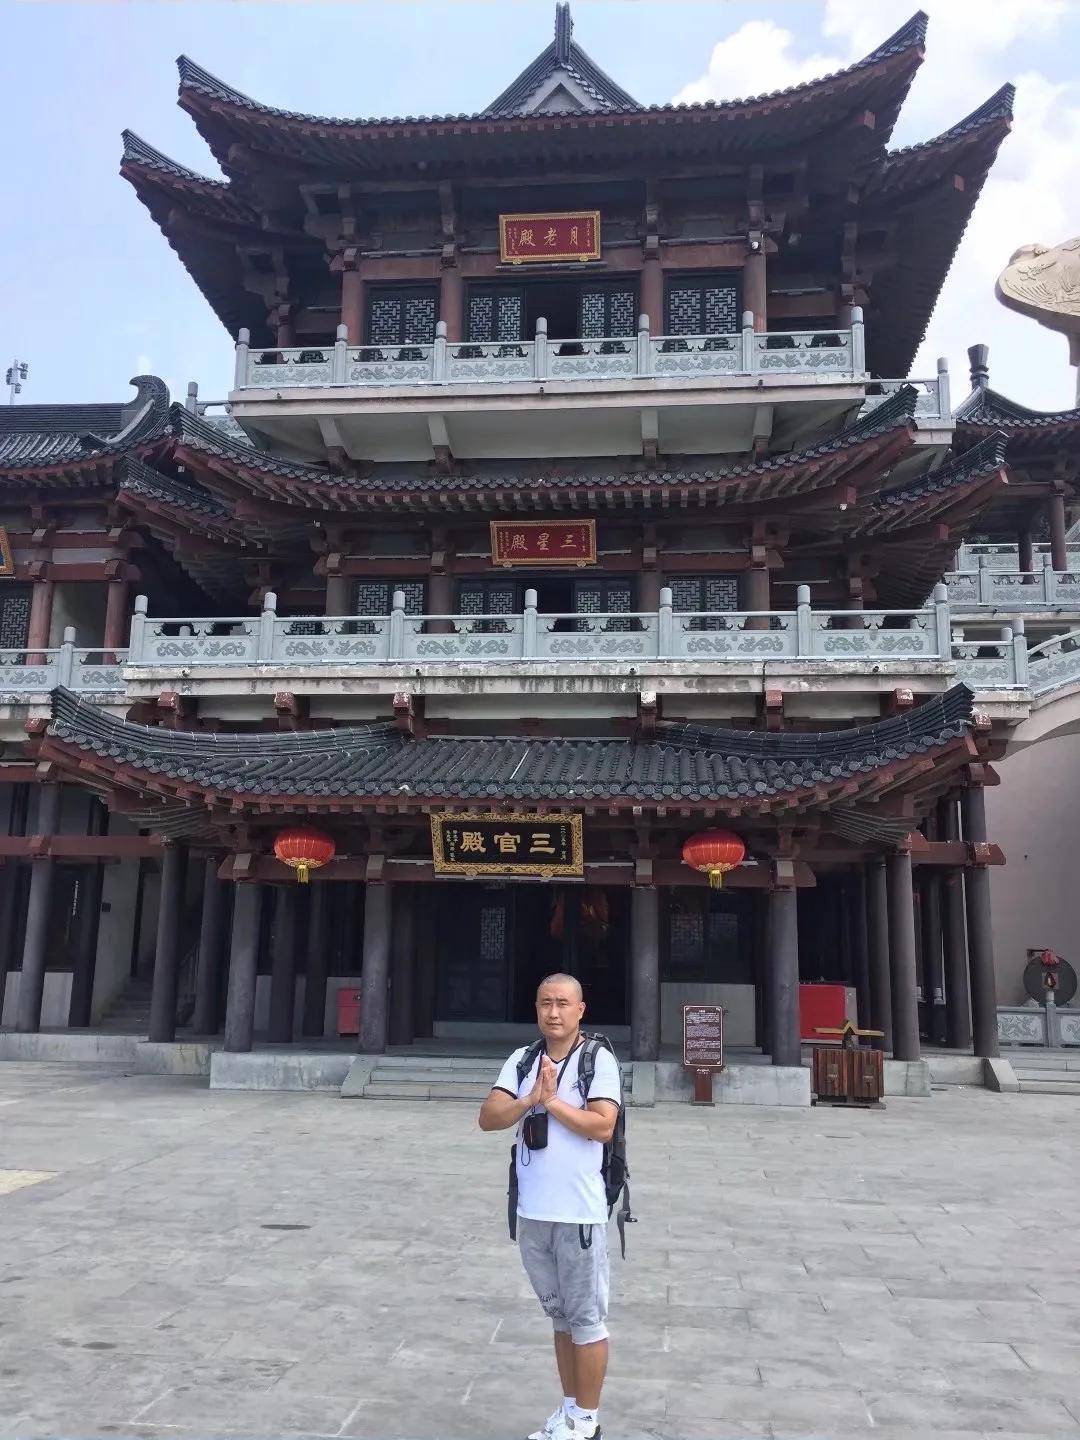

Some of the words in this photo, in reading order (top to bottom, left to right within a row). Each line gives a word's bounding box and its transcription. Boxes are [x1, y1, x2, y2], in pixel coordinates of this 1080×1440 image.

[510, 532, 577, 551] 三星殿
[460, 831, 556, 854] 三官殿
